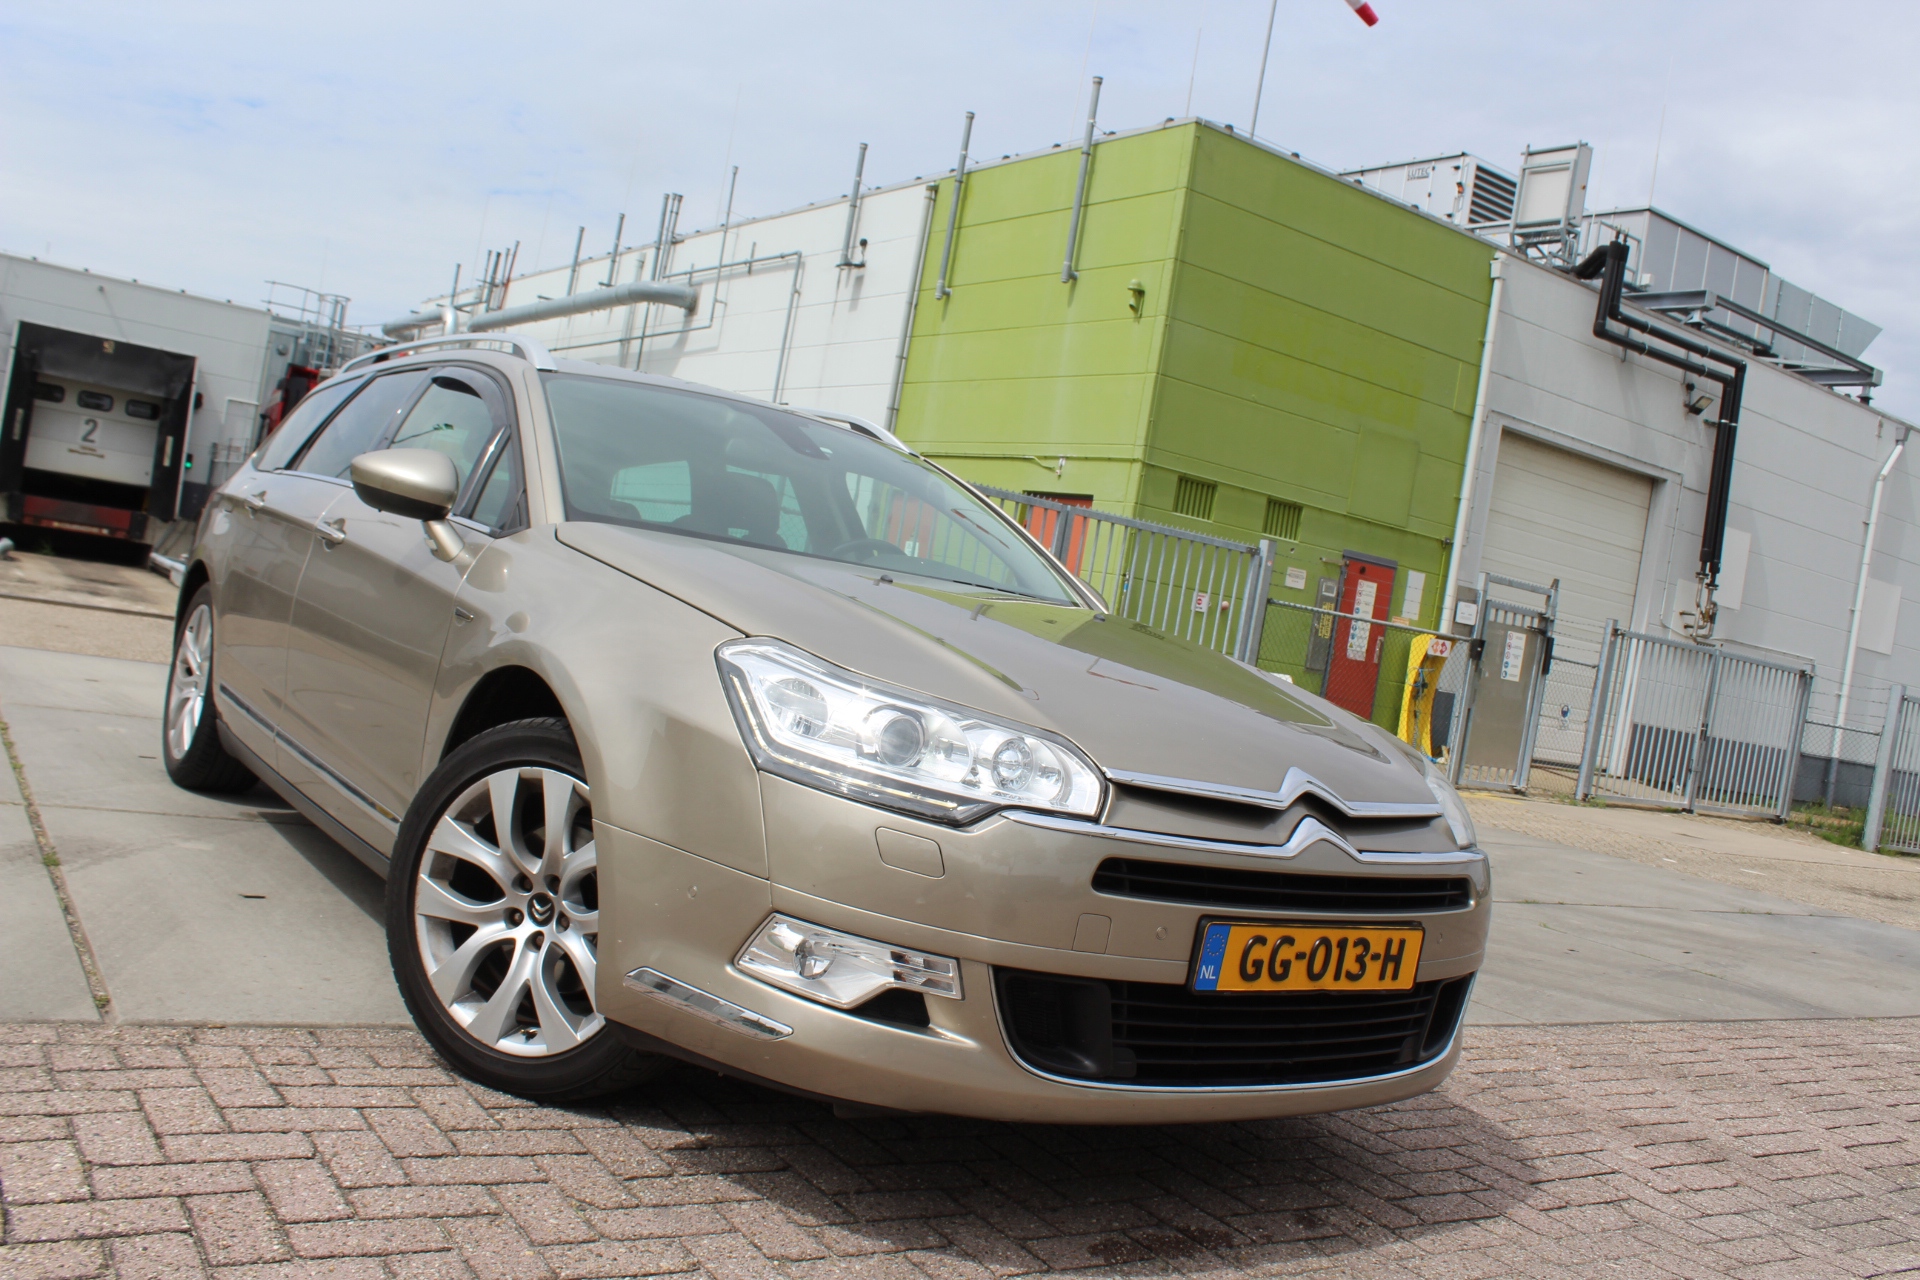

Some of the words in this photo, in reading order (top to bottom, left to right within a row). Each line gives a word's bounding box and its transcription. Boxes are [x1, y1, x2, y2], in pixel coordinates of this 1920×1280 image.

[82, 418, 98, 443] 2
[1238, 935, 1406, 982] GG-013-H
[1200, 965, 1216, 979] NL
